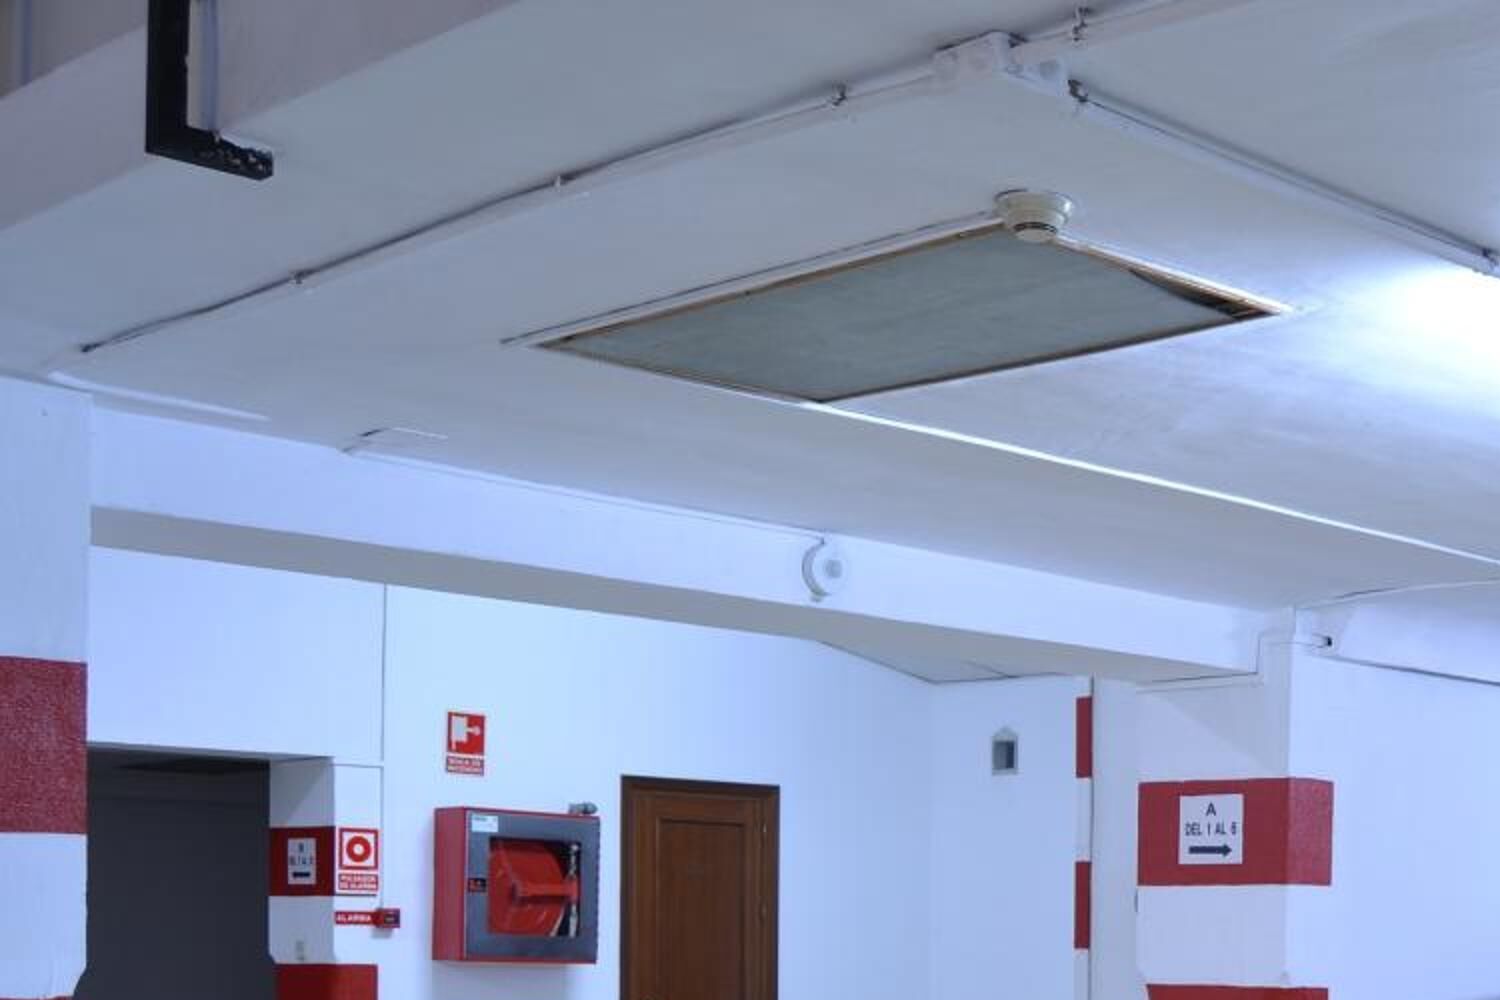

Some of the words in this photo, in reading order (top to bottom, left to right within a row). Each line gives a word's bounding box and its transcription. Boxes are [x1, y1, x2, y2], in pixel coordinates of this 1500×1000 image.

[1205, 802, 1217, 817] A
[1184, 821, 1202, 836] DEL
[1214, 820, 1227, 835] AL
[336, 914, 372, 922] ALARMA
